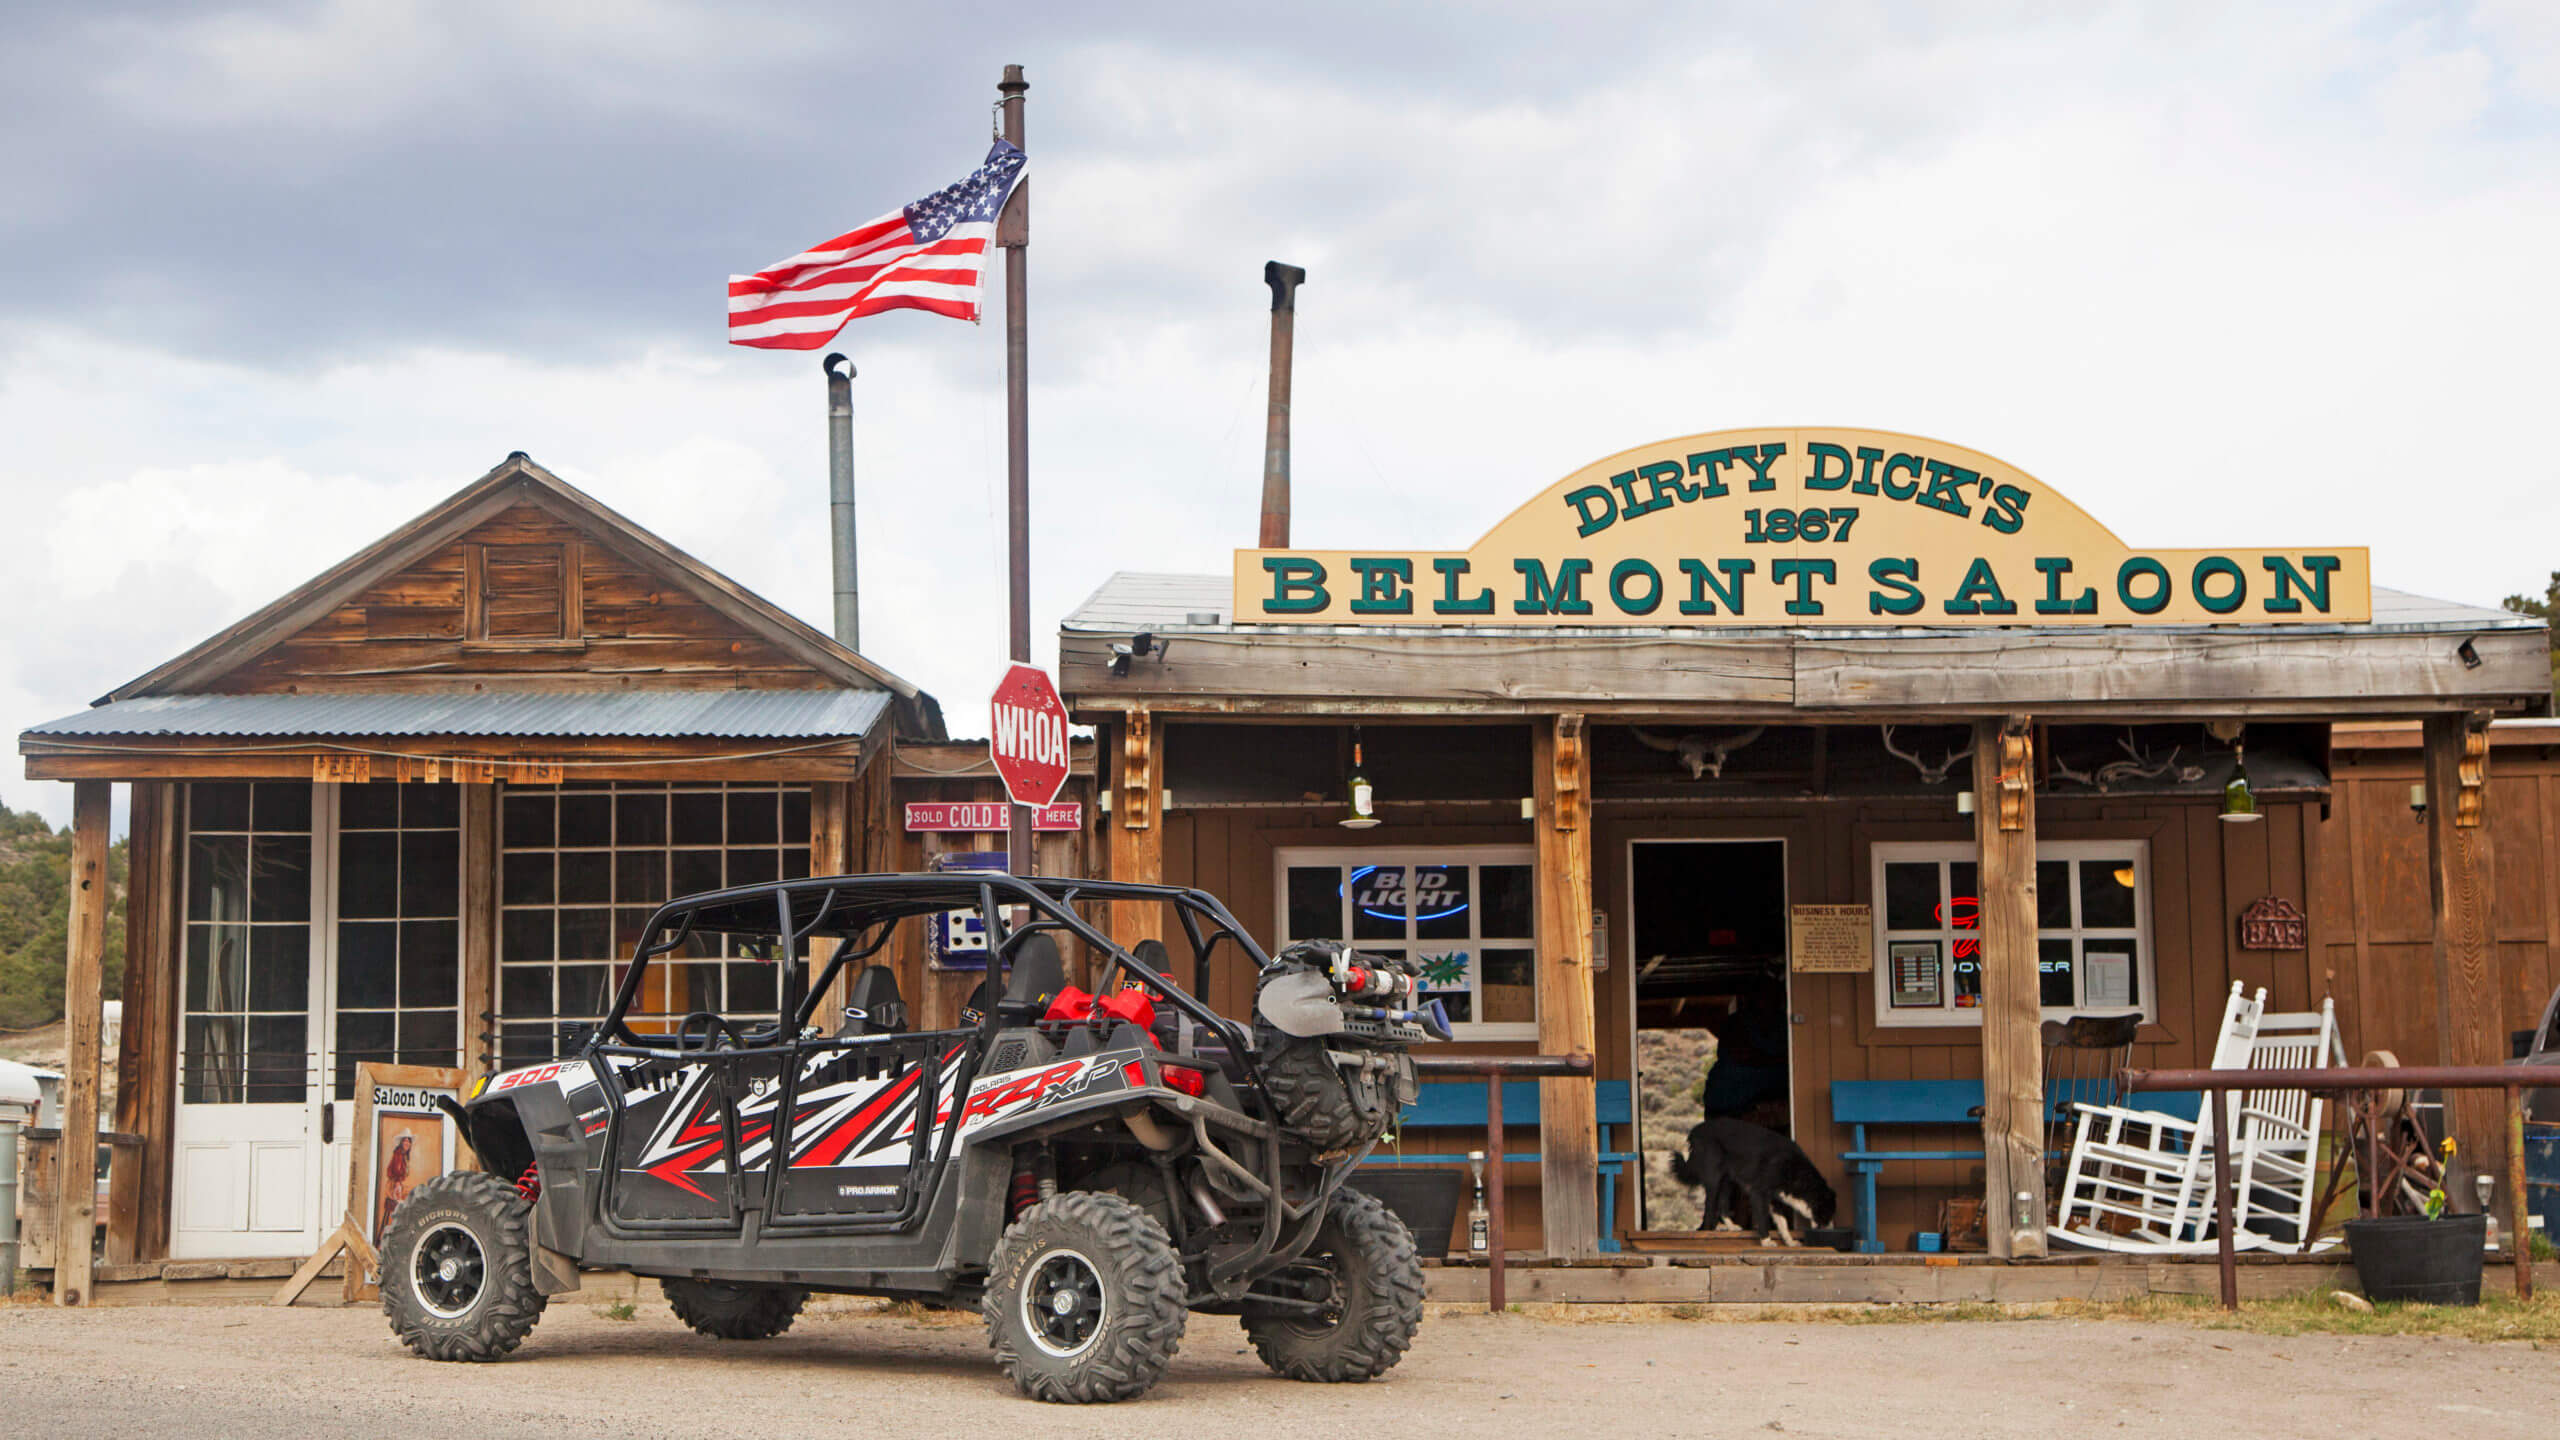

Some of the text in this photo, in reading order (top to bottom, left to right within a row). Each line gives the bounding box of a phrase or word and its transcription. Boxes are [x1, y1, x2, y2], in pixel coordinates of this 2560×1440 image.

[1564, 441, 2031, 538] DIRTY DICK'S
[1744, 508, 1859, 544] 1867
[1262, 556, 2342, 616] BELMONT SALOON
[992, 702, 1066, 768] WHOA
[914, 806, 1073, 829] SOLD COLD BR HERE
[1374, 872, 1448, 889] BUD
[1358, 890, 1462, 907] LIGHT
[1793, 907, 1870, 916] BUSINESS HOURS
[2246, 921, 2302, 944] BAR
[498, 1062, 585, 1090] 900 EFI
[973, 1075, 1012, 1094] POLARIS
[373, 1088, 416, 1107] Saloon
[958, 1059, 1119, 1130] RZR XP
[1008, 1239, 1046, 1290] MAXXIS
